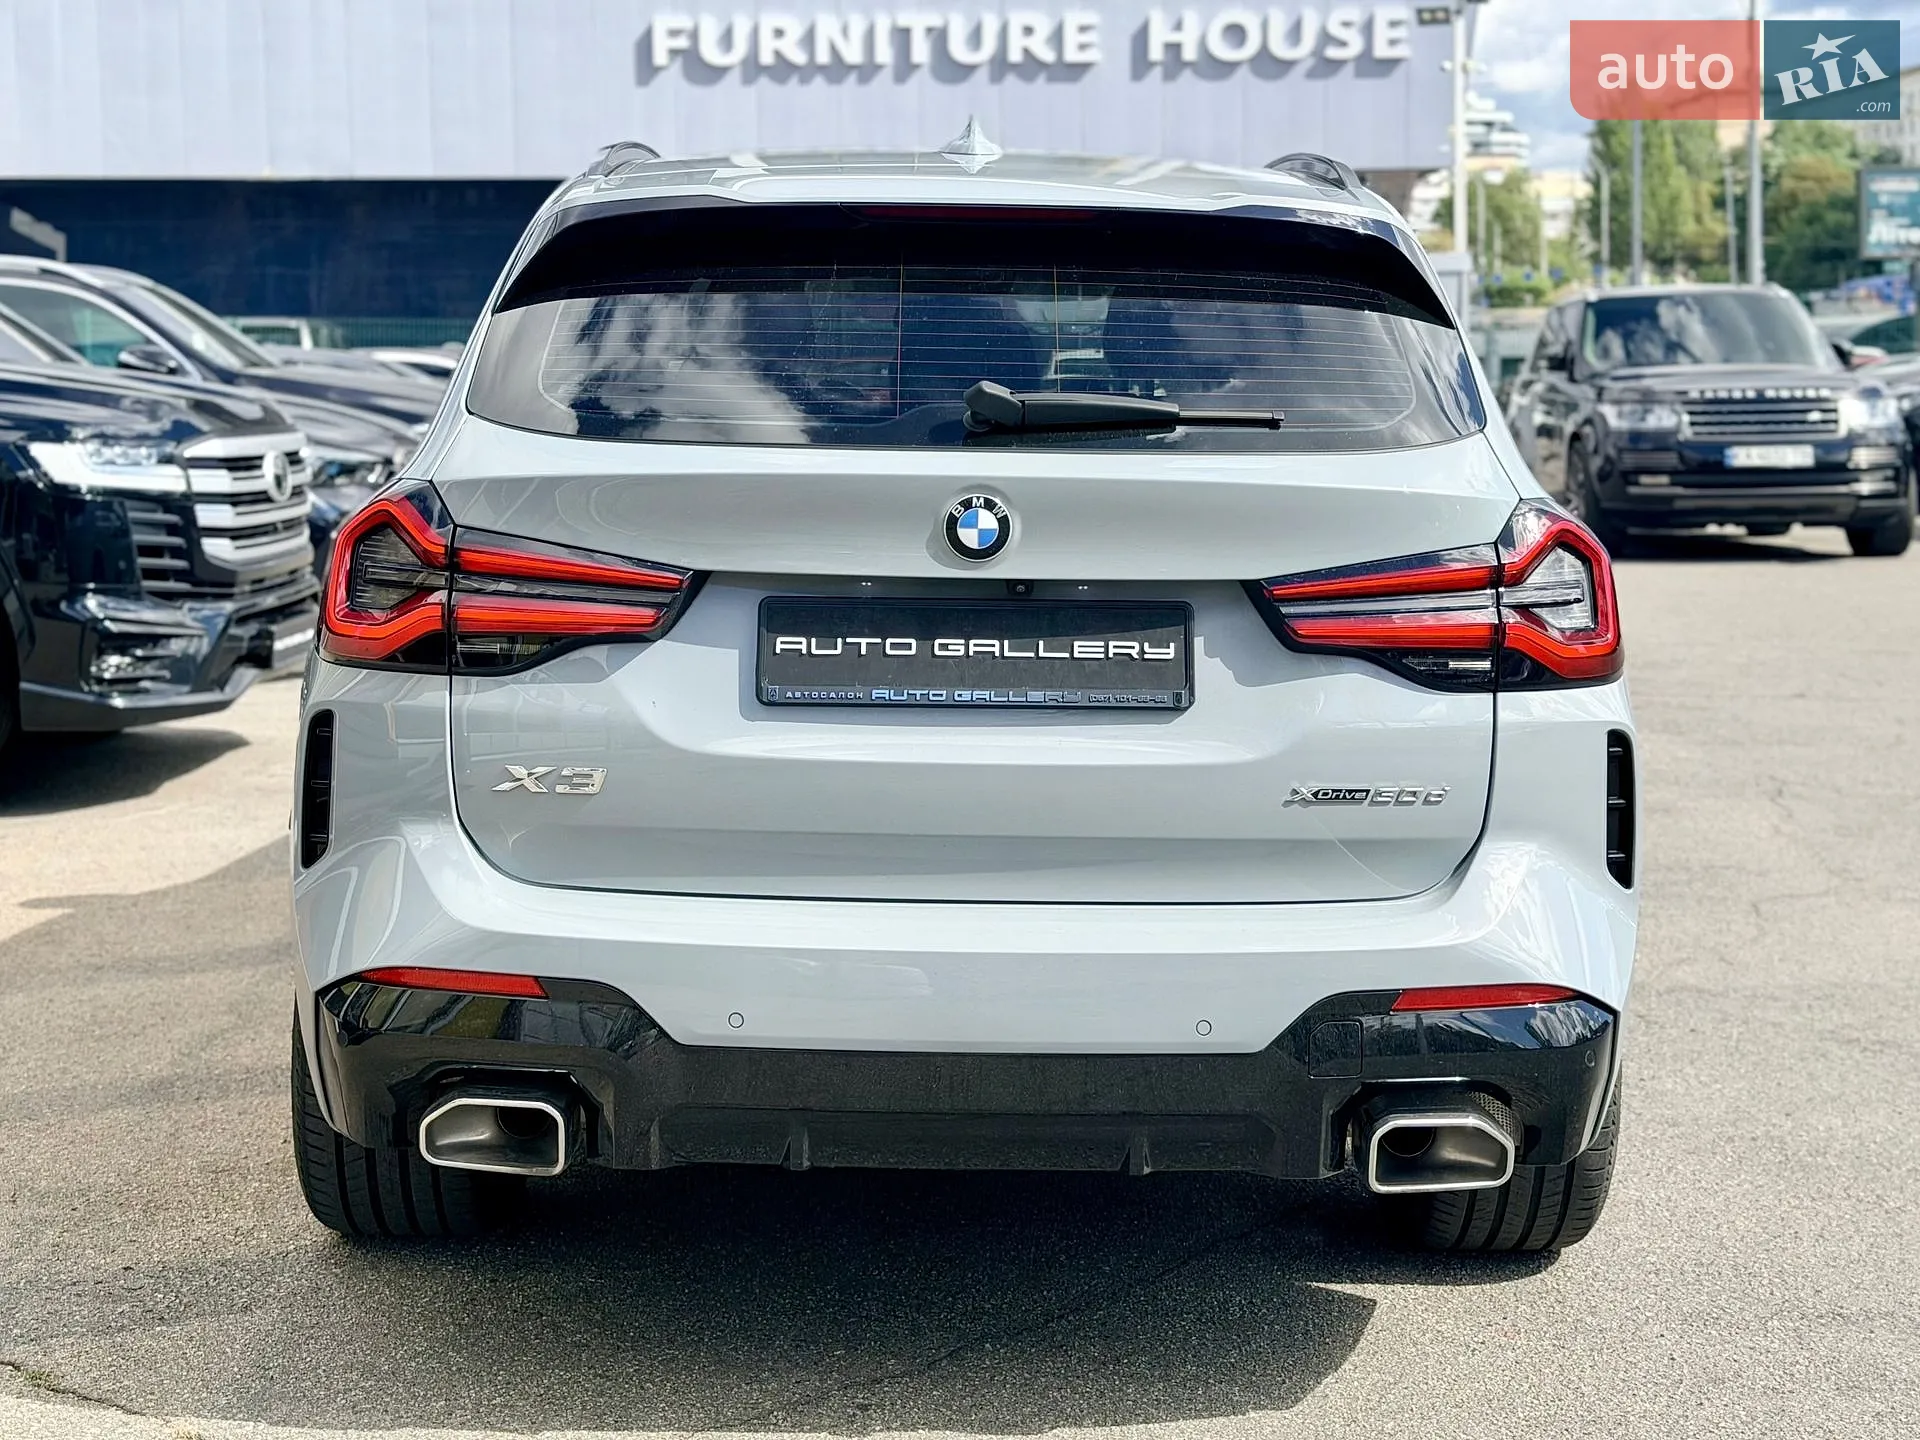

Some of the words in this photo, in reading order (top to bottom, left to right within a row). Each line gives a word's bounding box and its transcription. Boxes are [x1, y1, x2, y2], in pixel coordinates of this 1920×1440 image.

[650, 10, 1102, 68] FURNITURE
[1146, 5, 1414, 63] HOUSE
[951, 496, 1007, 518] BMW
[775, 636, 917, 656] AUTO
[933, 639, 1176, 660] GALLERY
[785, 690, 864, 700] АВТОСАЛОН
[871, 689, 947, 702] AUTO
[953, 690, 1081, 704] GALLERY
[491, 764, 608, 795] X3
